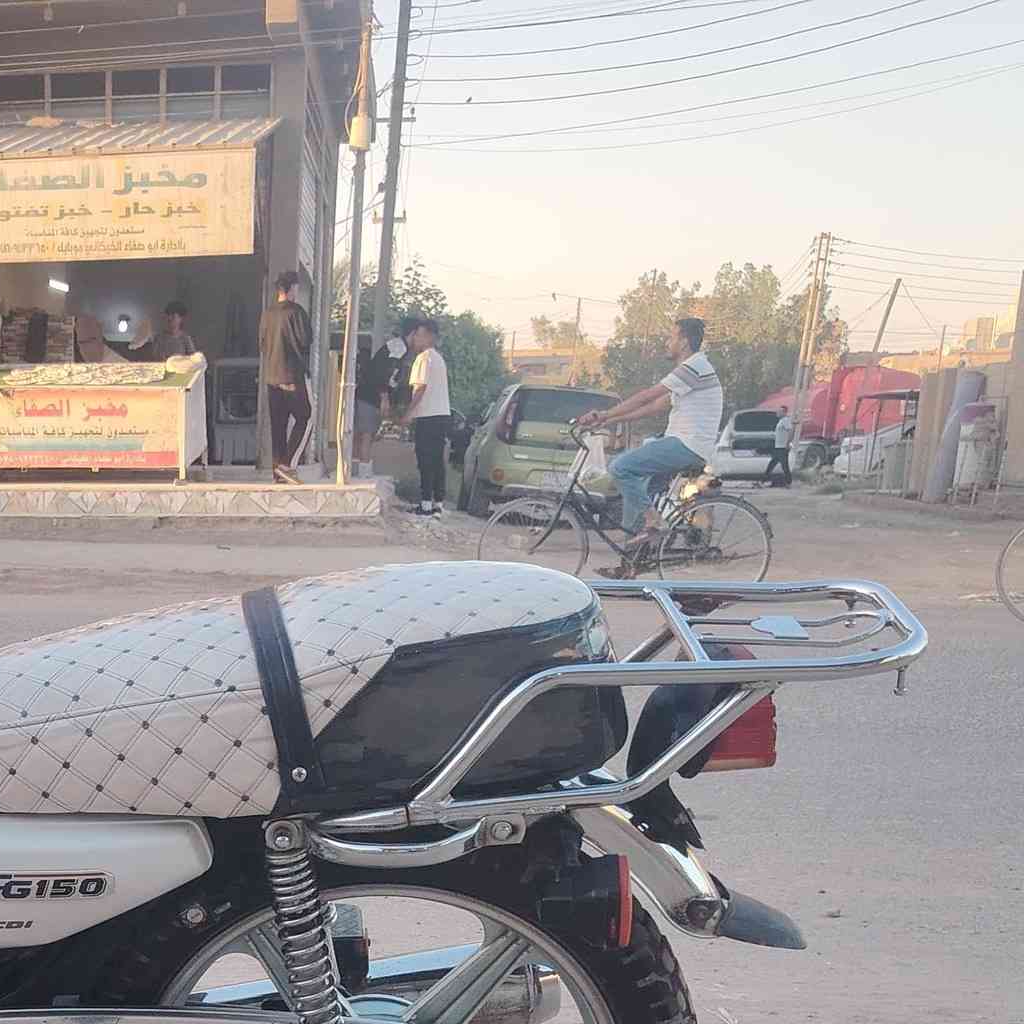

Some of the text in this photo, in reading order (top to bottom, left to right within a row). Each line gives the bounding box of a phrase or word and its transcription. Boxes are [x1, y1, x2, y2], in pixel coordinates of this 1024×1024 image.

[113, 163, 207, 195] مخبز
[54, 204, 93, 220] خبز
[160, 202, 201, 218] خبز
[80, 398, 128, 421] مخبز
